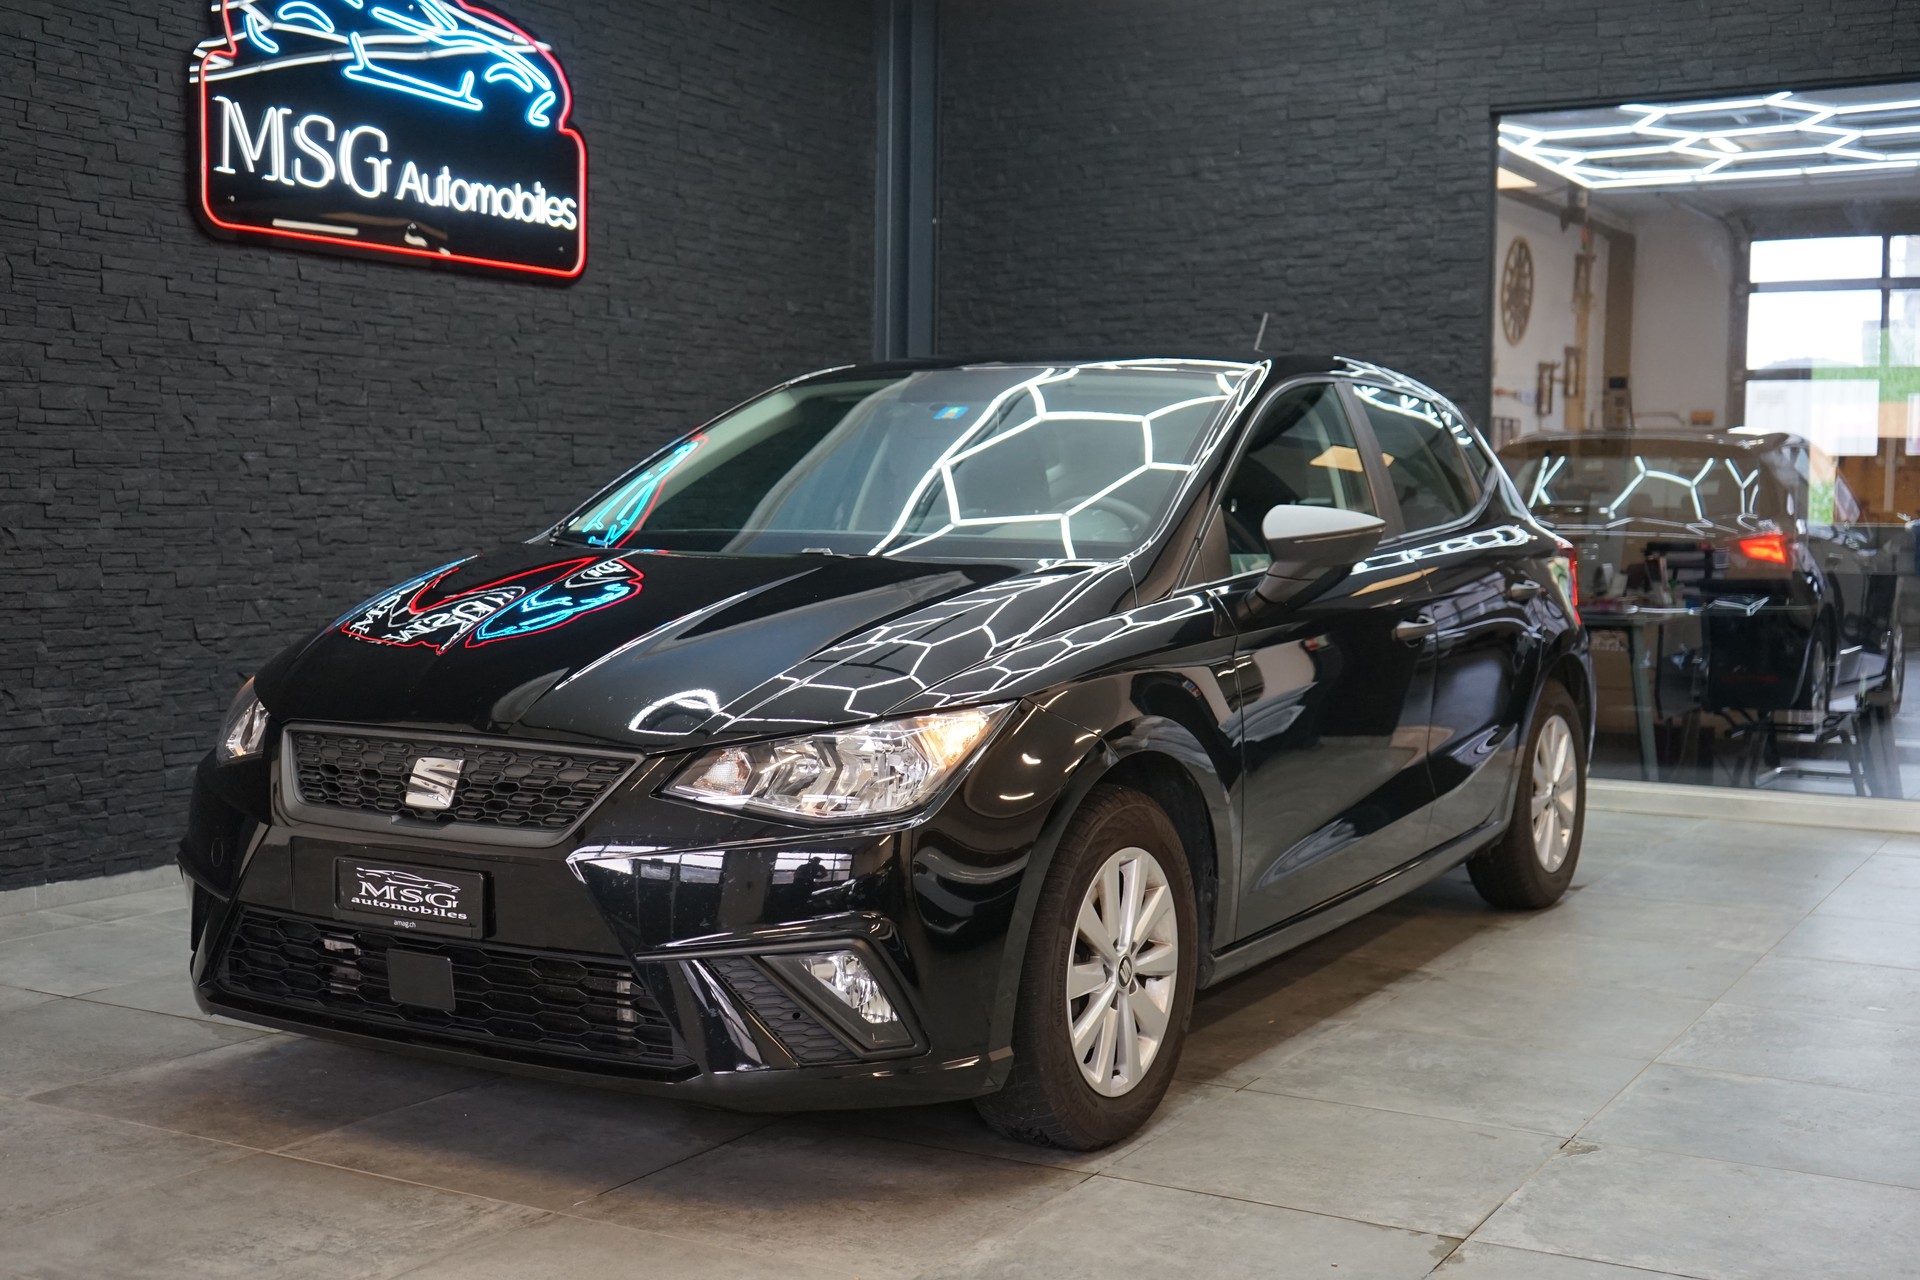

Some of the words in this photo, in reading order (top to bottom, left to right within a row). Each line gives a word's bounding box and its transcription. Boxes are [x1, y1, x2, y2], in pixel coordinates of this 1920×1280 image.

[212, 95, 392, 198] MSG
[394, 161, 578, 231] Automobiles
[359, 880, 459, 909] MSG
[351, 896, 468, 920] automobiles
[393, 919, 417, 929] amag.ch
